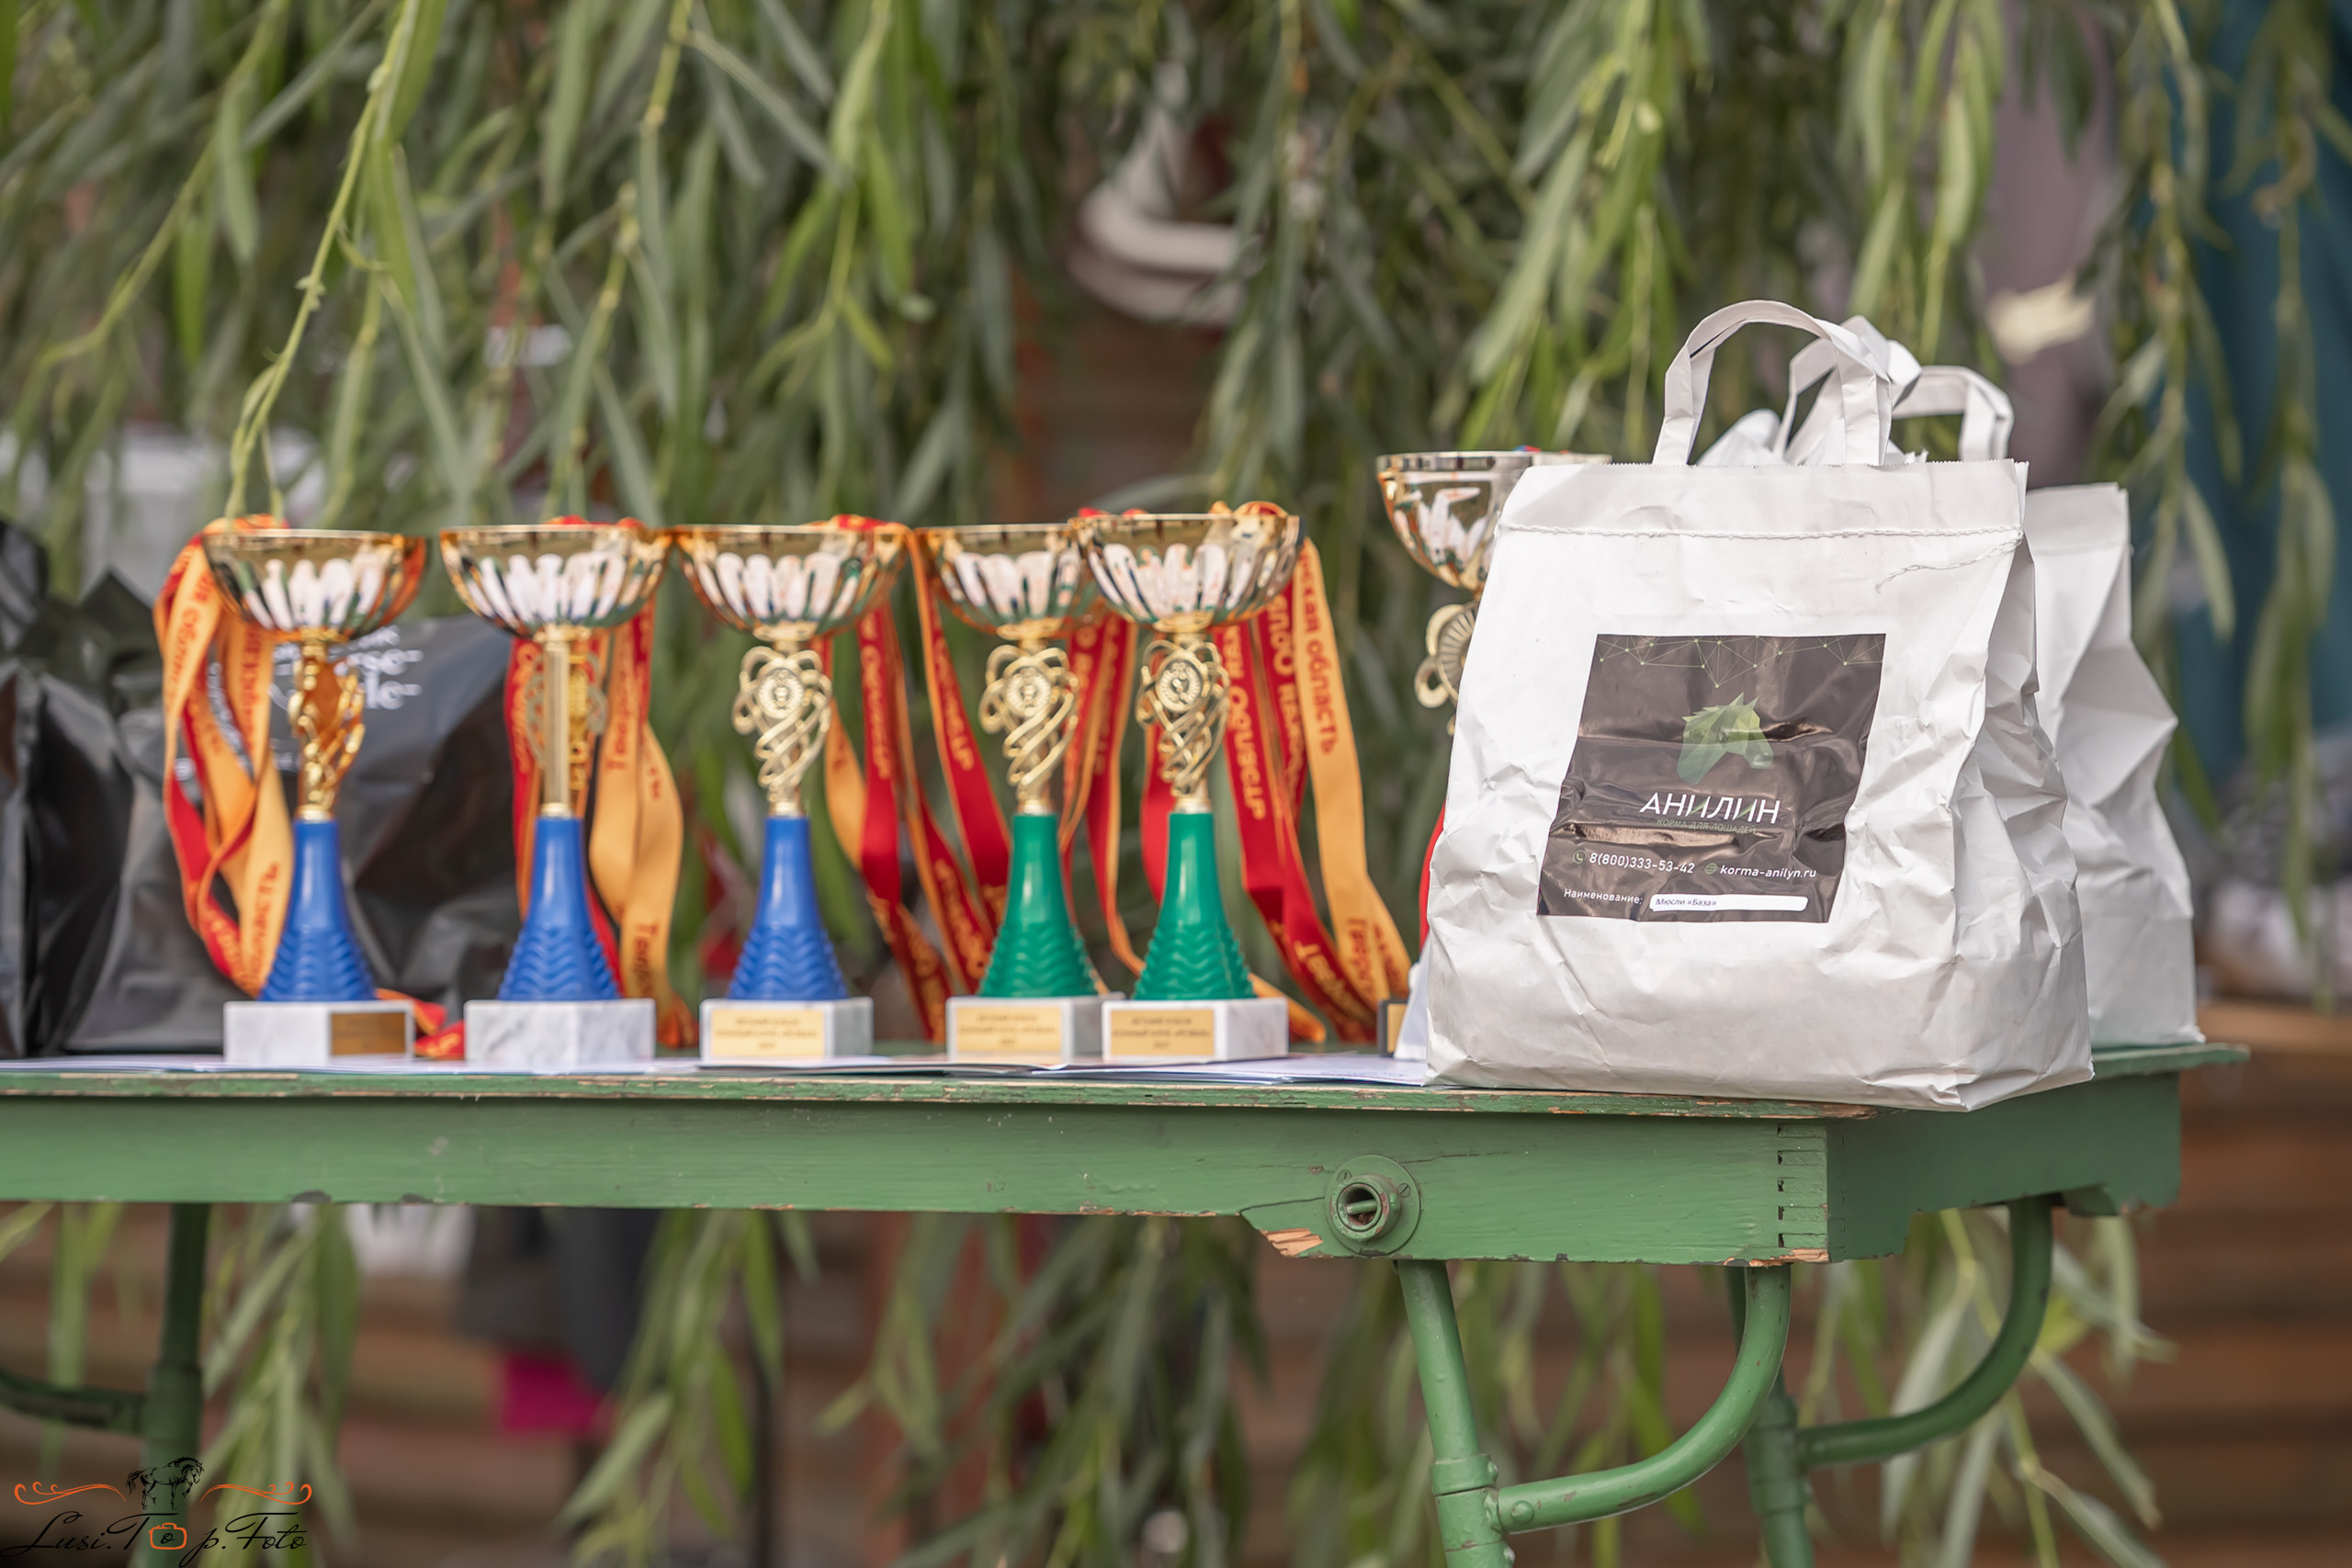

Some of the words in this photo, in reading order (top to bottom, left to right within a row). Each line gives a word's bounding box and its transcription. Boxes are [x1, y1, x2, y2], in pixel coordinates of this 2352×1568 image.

[1639, 792, 1781, 825] АНИЛИН
[1657, 818, 1687, 828] КОРМА
[1689, 821, 1709, 830] ДЛЯ
[1711, 823, 1757, 834] ЛОШАДЕЙ
[1589, 852, 1696, 874] 8(800)333-53-42
[1720, 864, 1817, 880] korma-anilyn.ru
[1564, 888, 1643, 905] Наименование:
[1655, 897, 1686, 906] Мюсли
[1687, 897, 1717, 907] «База»
